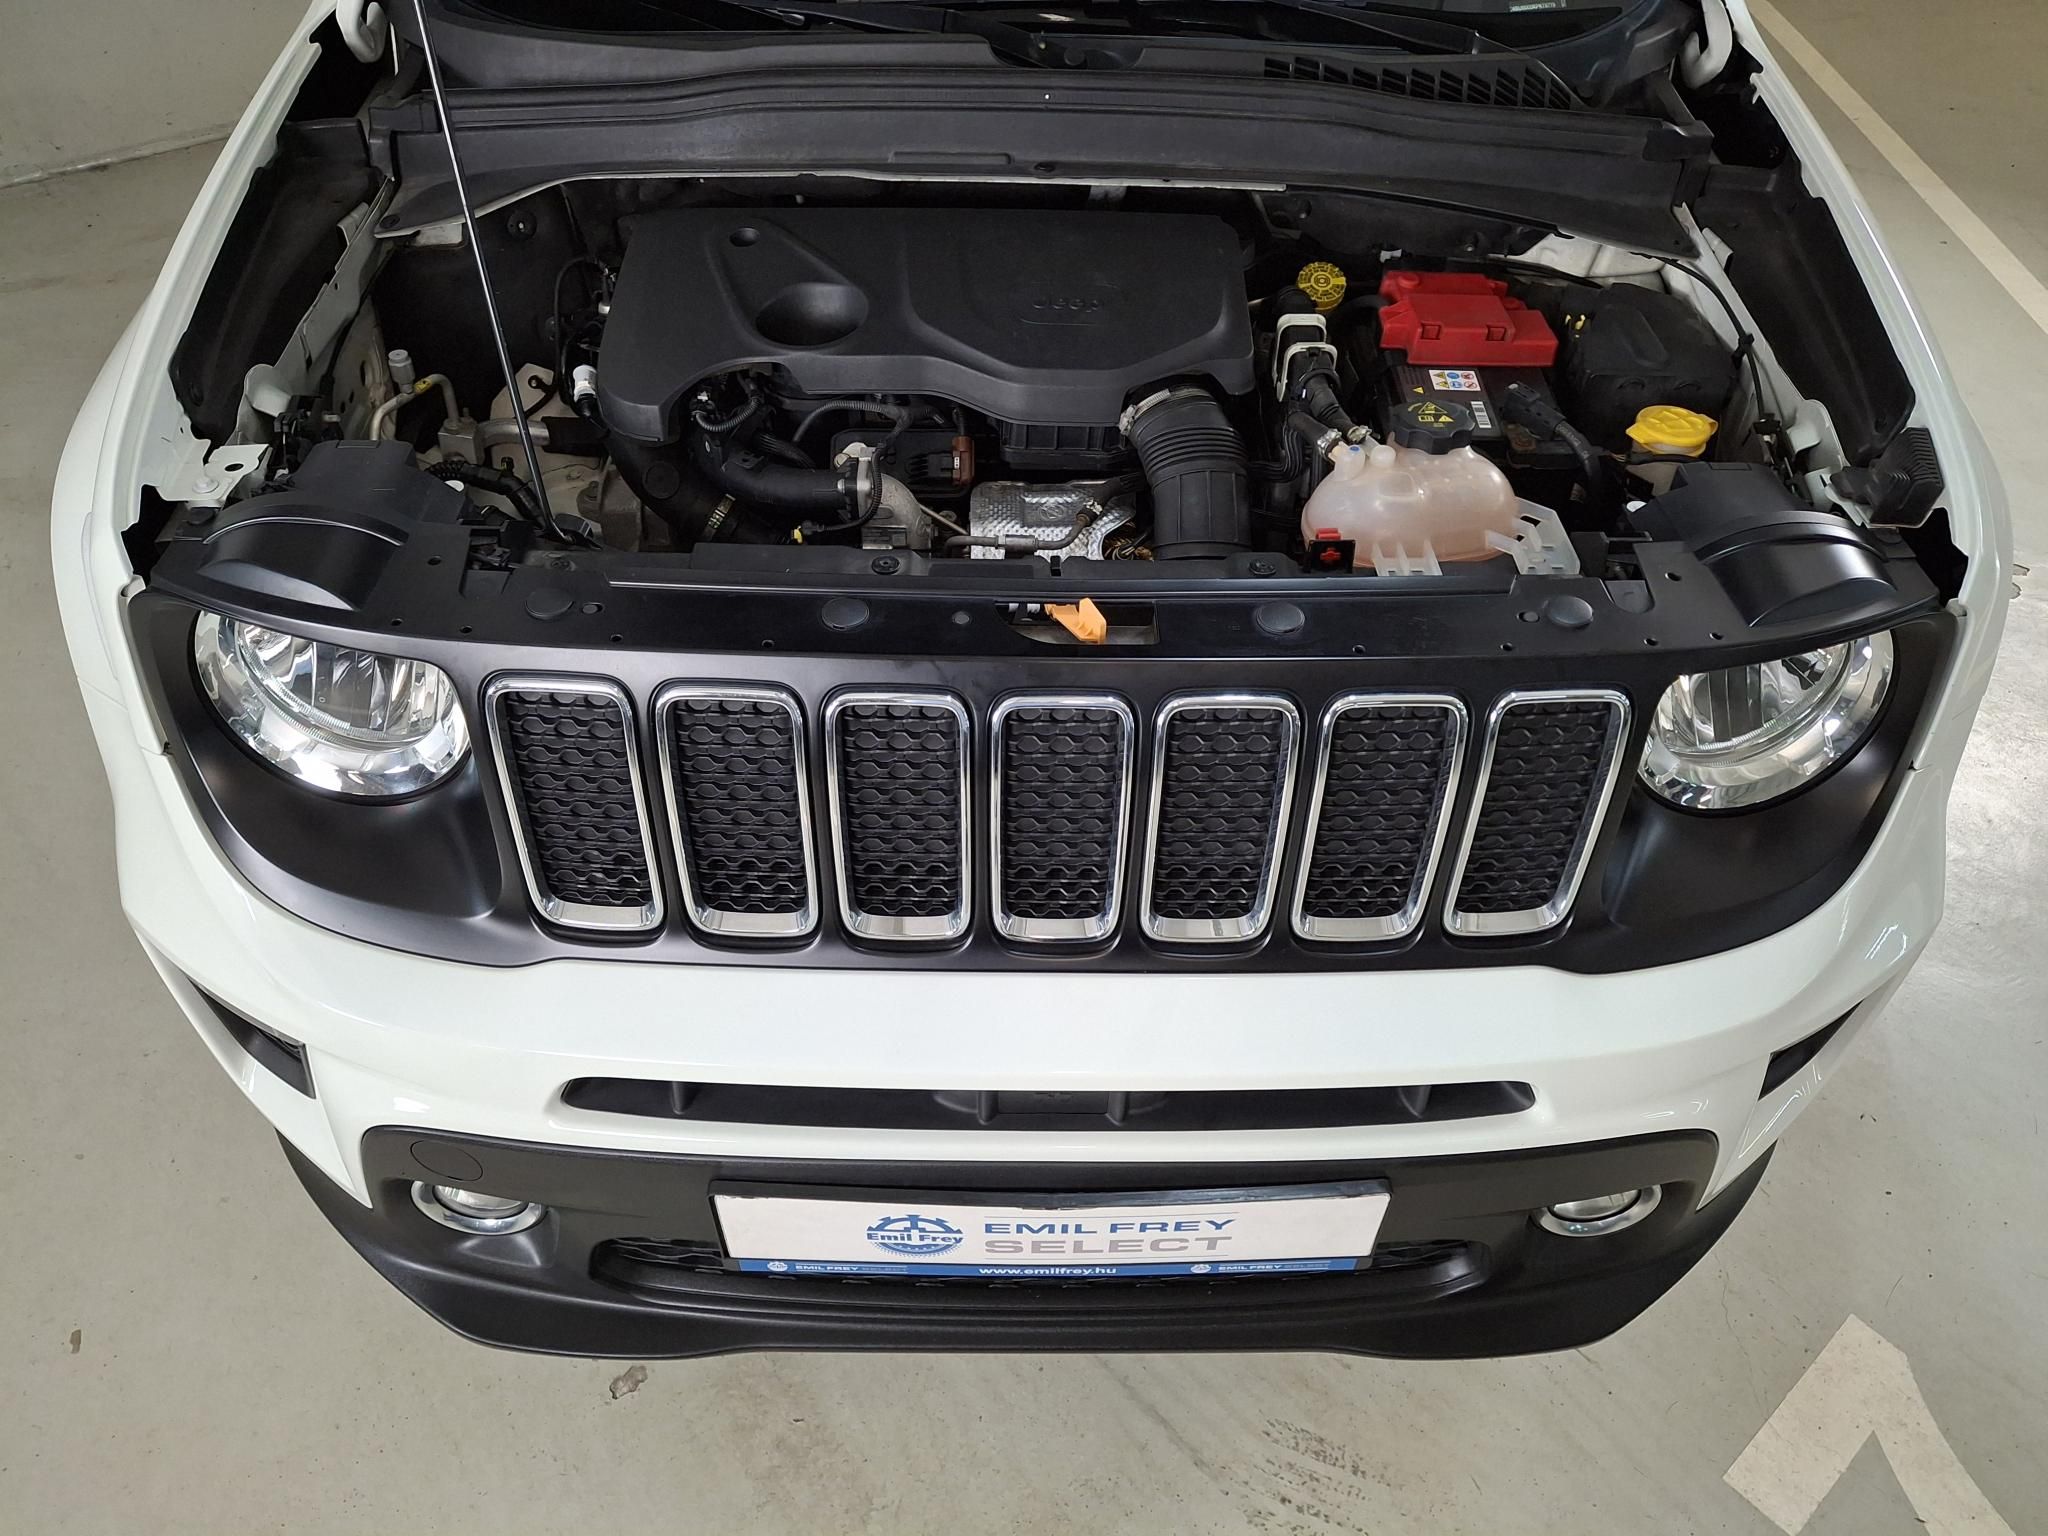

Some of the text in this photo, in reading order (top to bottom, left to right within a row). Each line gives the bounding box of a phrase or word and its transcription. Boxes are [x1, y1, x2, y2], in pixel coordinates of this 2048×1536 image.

[985, 1219, 1237, 1234] EMIL FREY
[866, 1232, 964, 1245] Emil Frey
[984, 1236, 1233, 1254] SELECT
[978, 1266, 1117, 1276] www.emilfrey.hu
